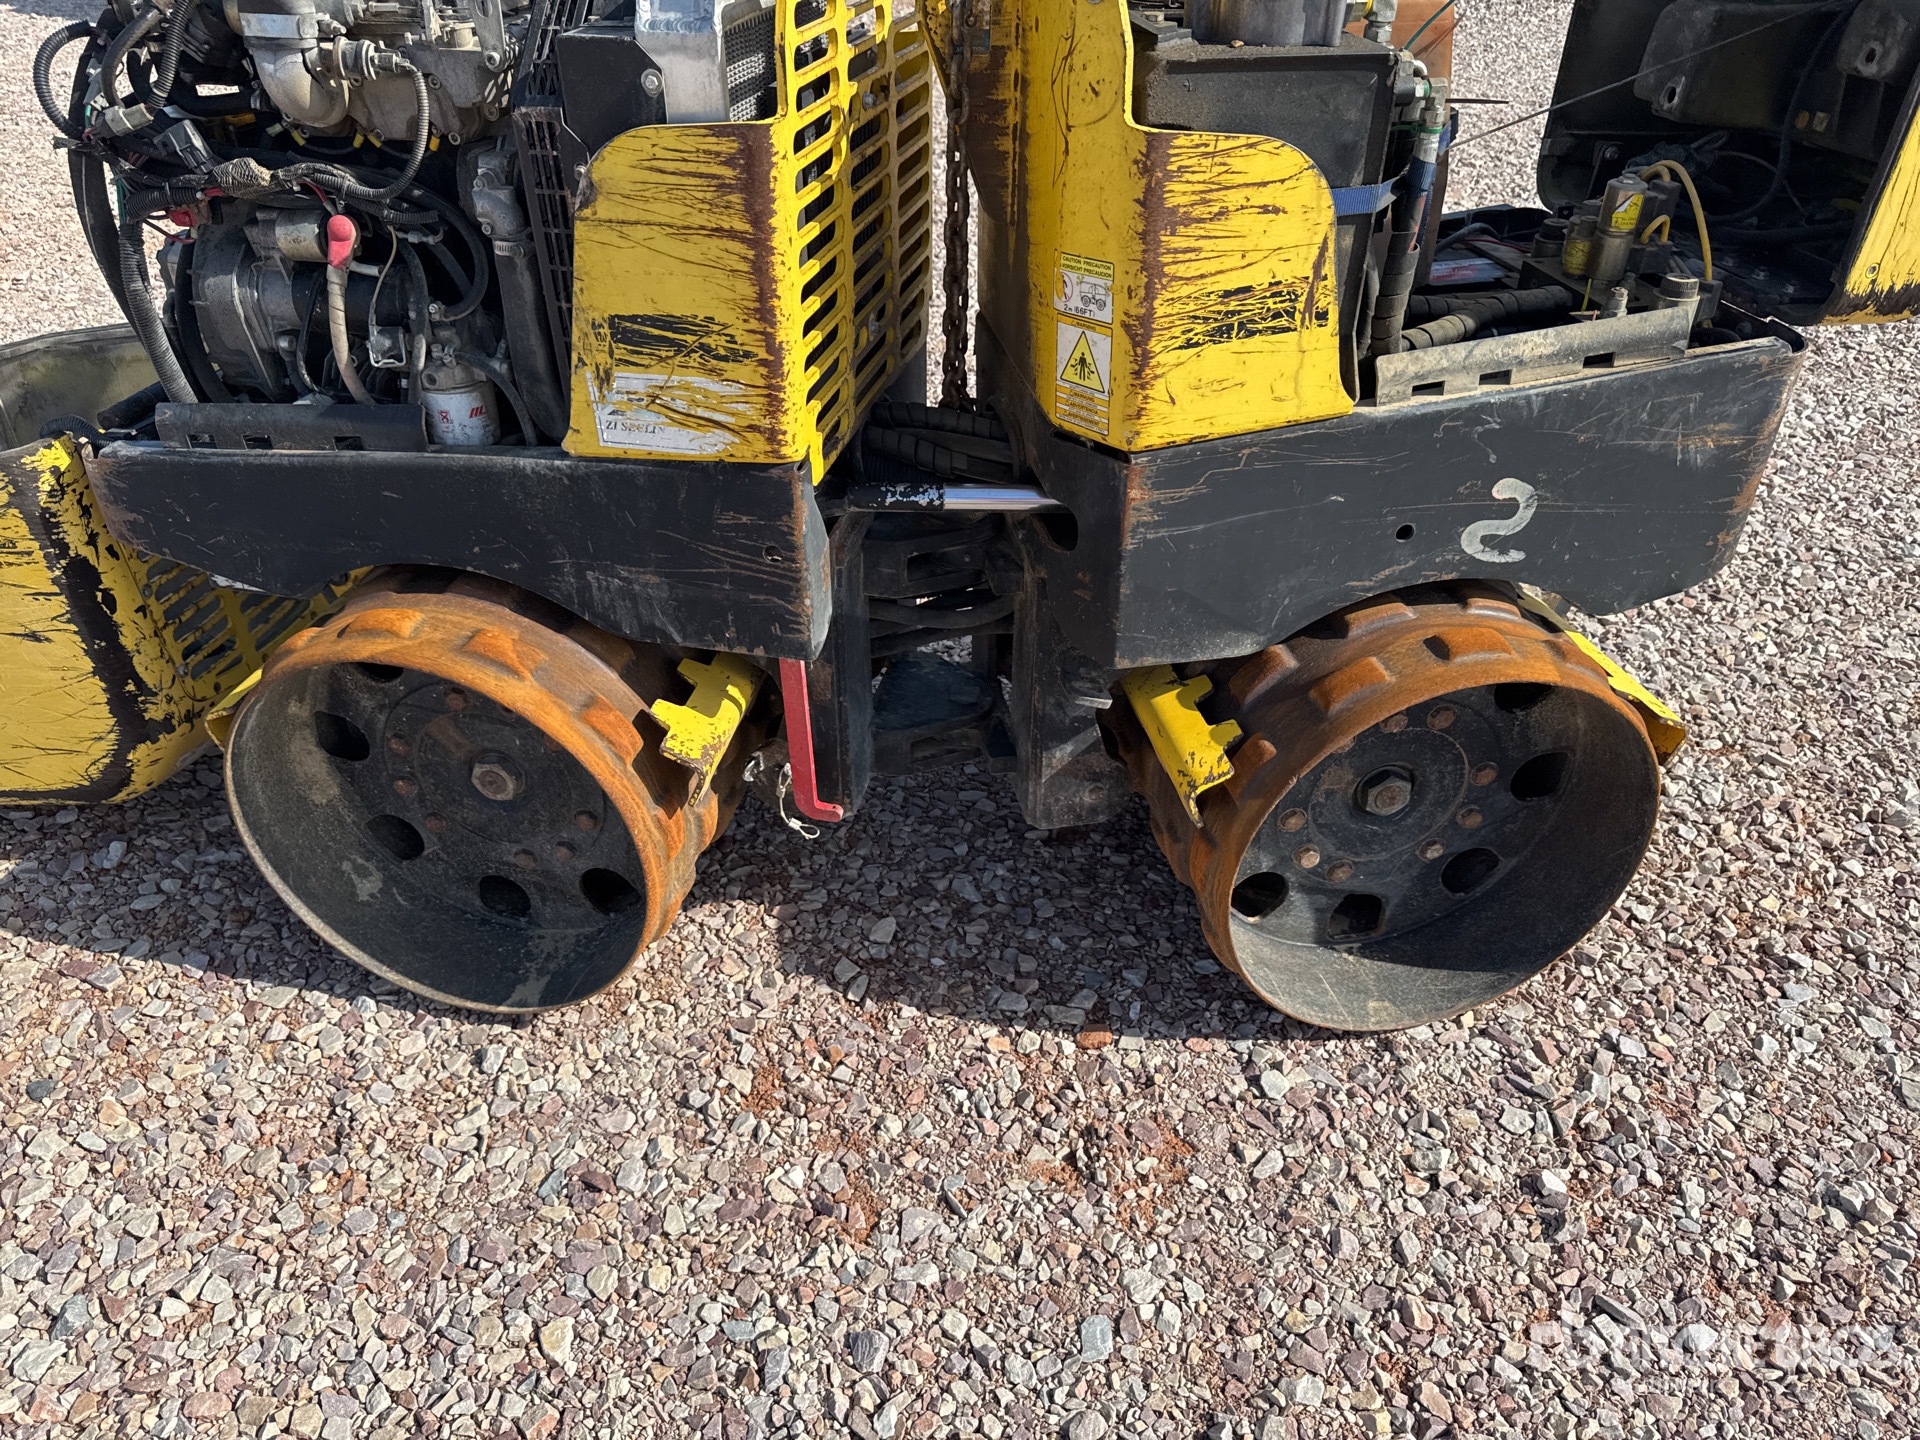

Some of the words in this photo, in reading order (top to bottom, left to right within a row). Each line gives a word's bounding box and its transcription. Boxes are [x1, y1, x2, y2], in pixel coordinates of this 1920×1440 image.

[1062, 263, 1083, 272] VORSICHT
[1083, 268, 1112, 278] PRECAUCION
[1063, 256, 1081, 264] CAUTION
[1083, 260, 1111, 271] PRECAUTION
[605, 420, 618, 430] ZI
